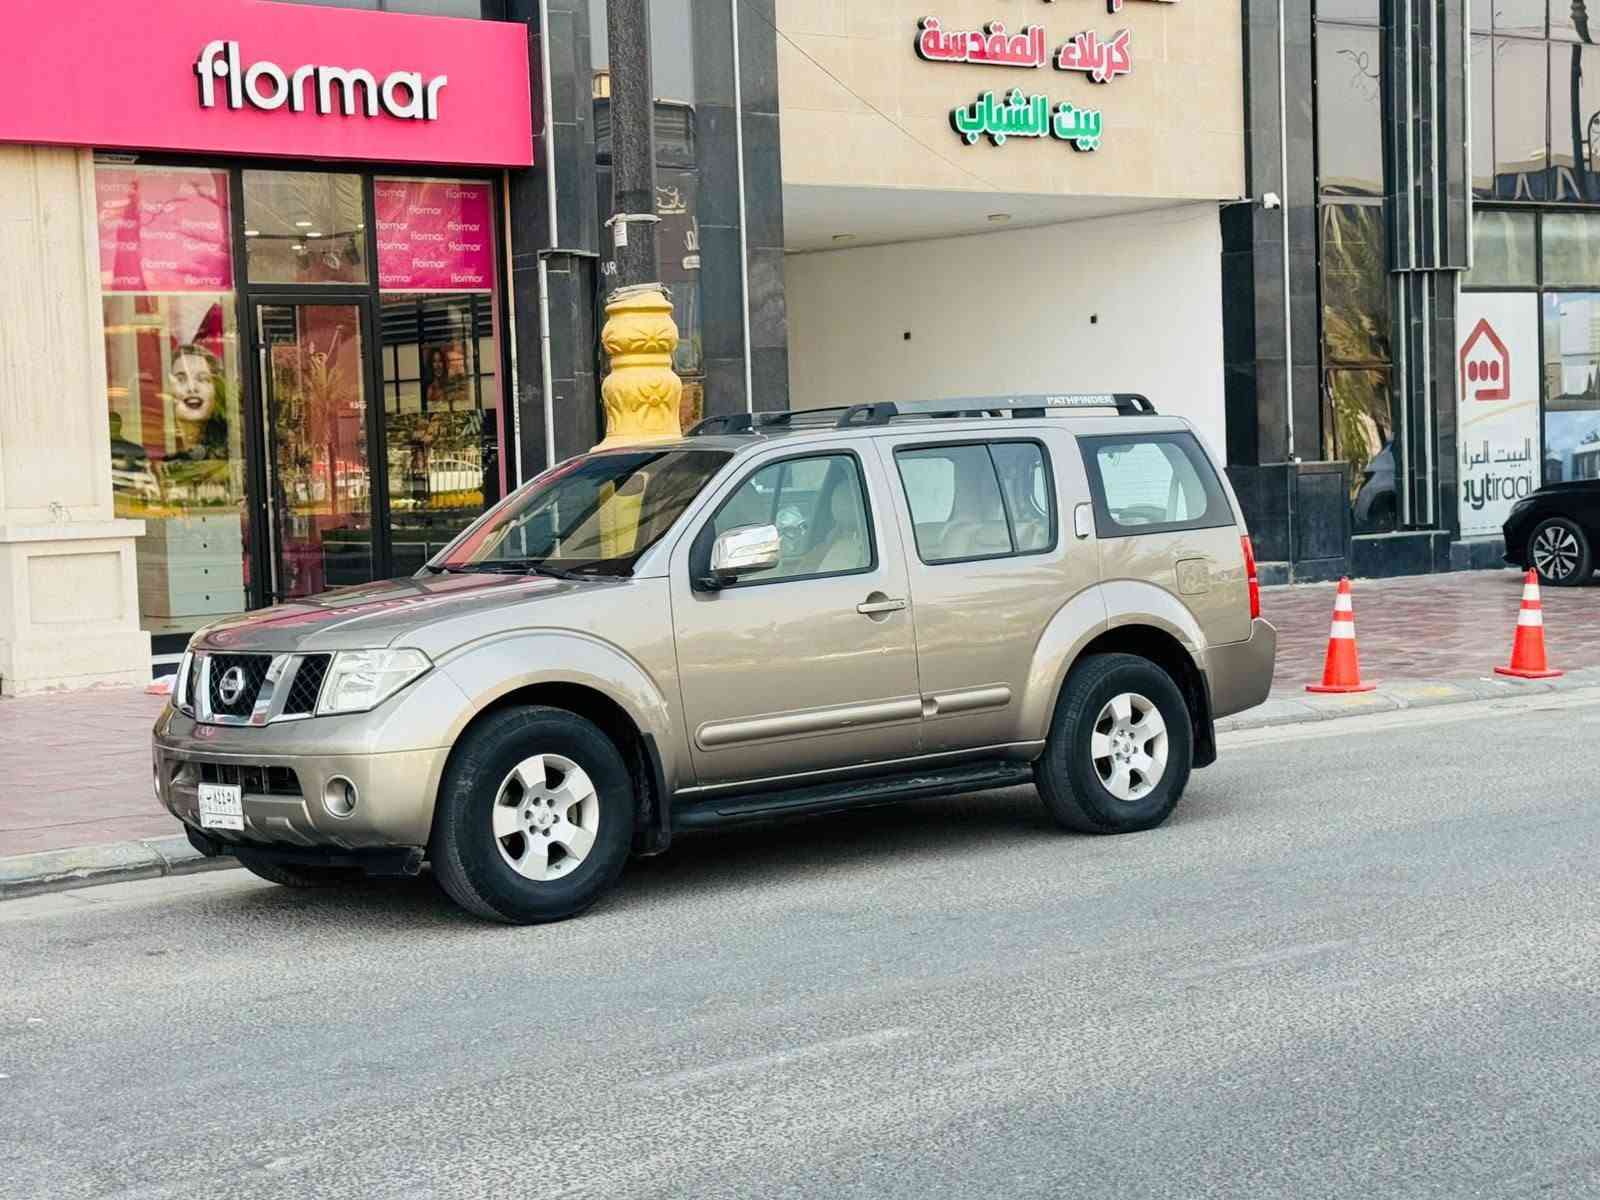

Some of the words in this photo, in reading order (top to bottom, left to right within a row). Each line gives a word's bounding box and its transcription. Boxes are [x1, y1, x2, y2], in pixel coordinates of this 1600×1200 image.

[916, 16, 1046, 67] المقدسة
[1056, 26, 1132, 82] كربلاء
[195, 39, 448, 121] flormar
[952, 88, 1049, 145] الشباب
[1052, 102, 1102, 150] بيت
[447, 221, 481, 232] flormar
[450, 273, 484, 284] flormar
[1493, 438, 1531, 467] البيت
